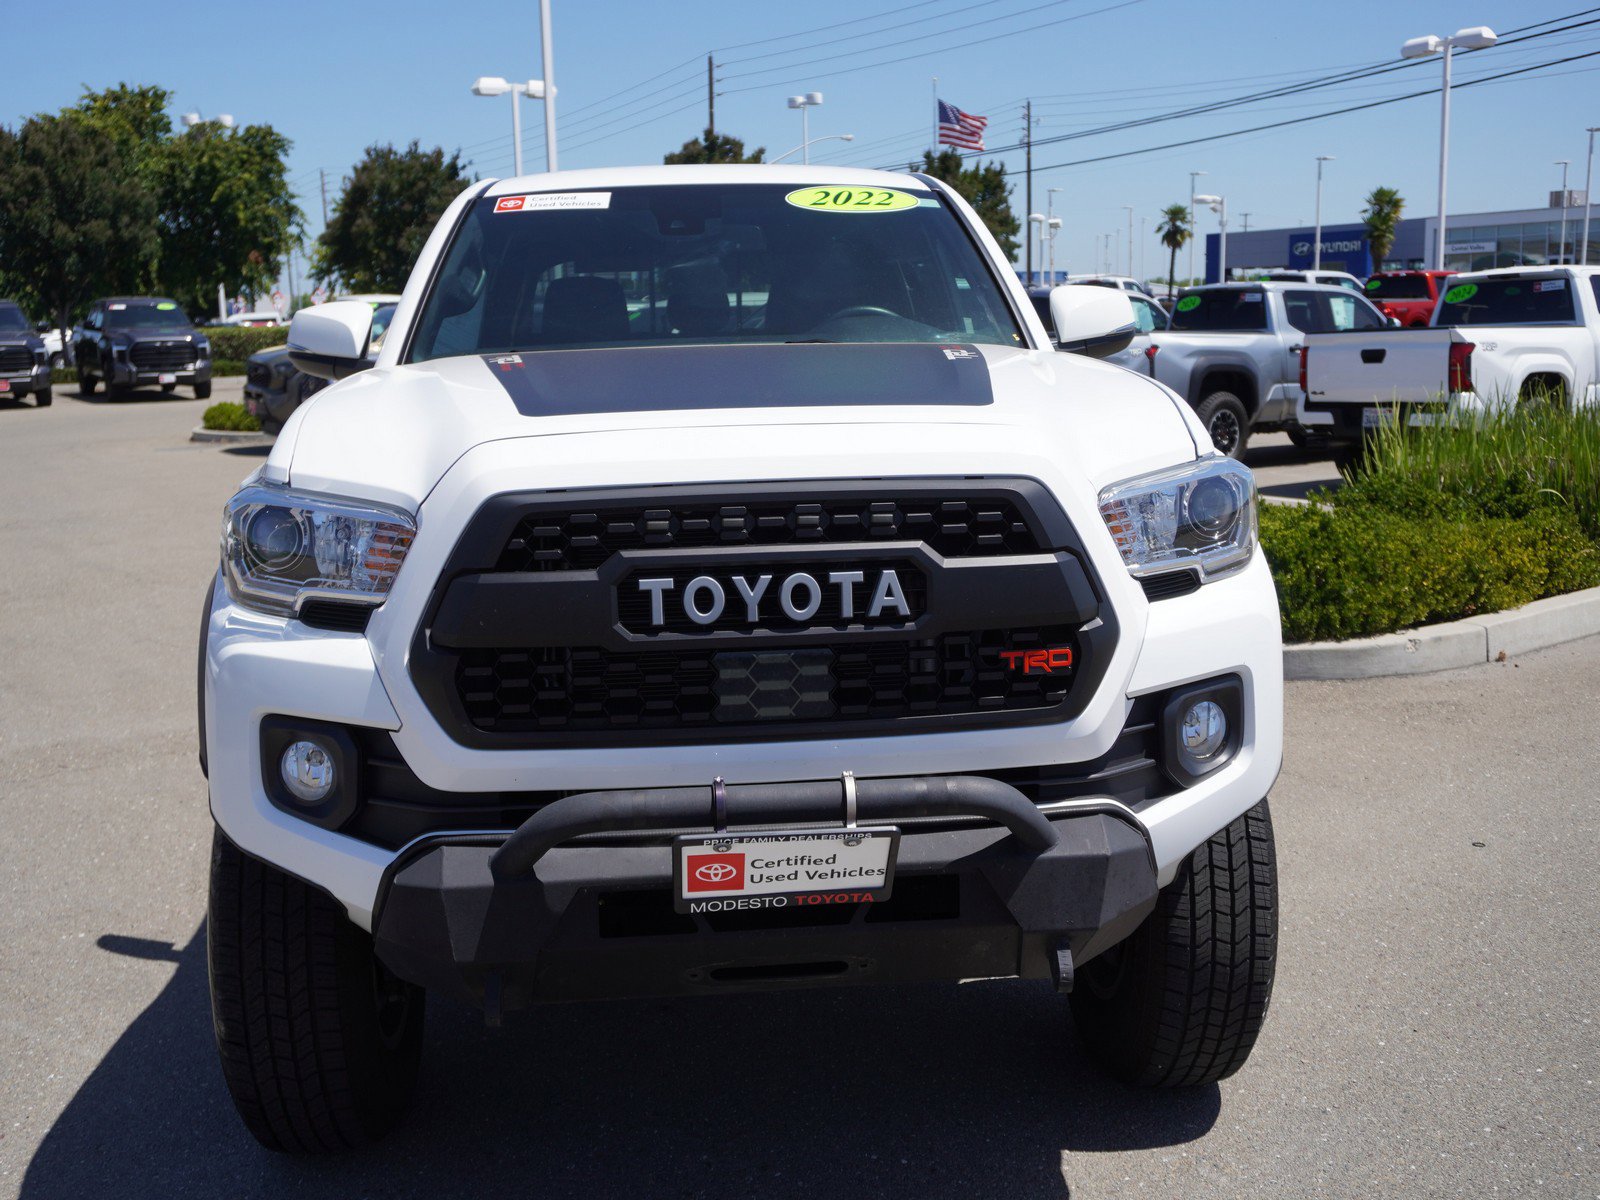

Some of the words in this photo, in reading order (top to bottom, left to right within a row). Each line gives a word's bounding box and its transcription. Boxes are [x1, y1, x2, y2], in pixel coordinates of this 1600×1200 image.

[810, 190, 894, 206] 2022
[638, 570, 911, 625] TOYOTA
[1000, 648, 1073, 674] TRD
[743, 836, 786, 844] FAMILY
[750, 853, 837, 869] Certified
[750, 870, 798, 884] Used
[805, 866, 885, 881] Vehicles
[690, 896, 788, 914] MODESTO
[795, 892, 874, 906] TOYOTA
